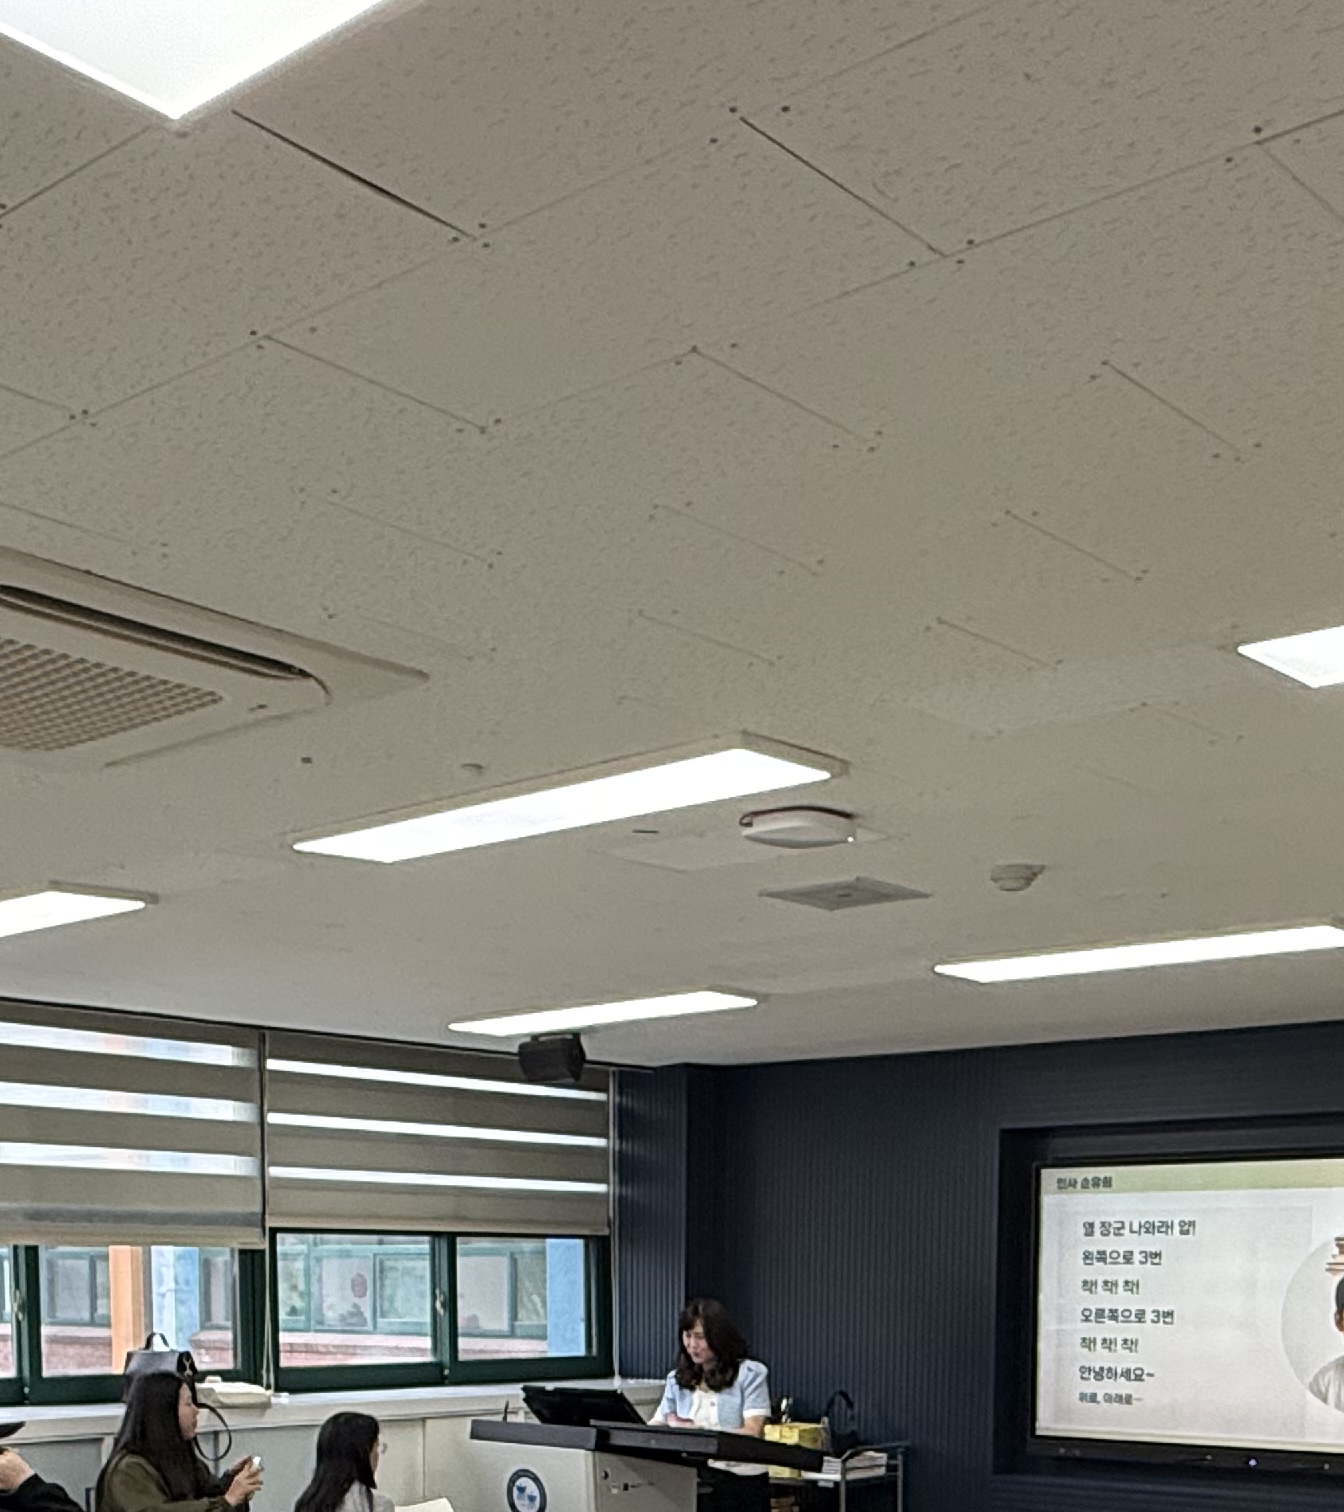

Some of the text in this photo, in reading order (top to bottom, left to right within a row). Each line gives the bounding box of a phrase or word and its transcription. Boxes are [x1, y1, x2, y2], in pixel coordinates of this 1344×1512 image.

[1099, 1220, 1126, 1237] 장군
[1129, 1219, 1174, 1237] 나와라!
[1082, 1250, 1163, 1266] 왼쪽으로 3번
[1080, 1308, 1175, 1326] 오른쪽으로 3번
[1078, 1365, 1155, 1383] 안녕하세요~
